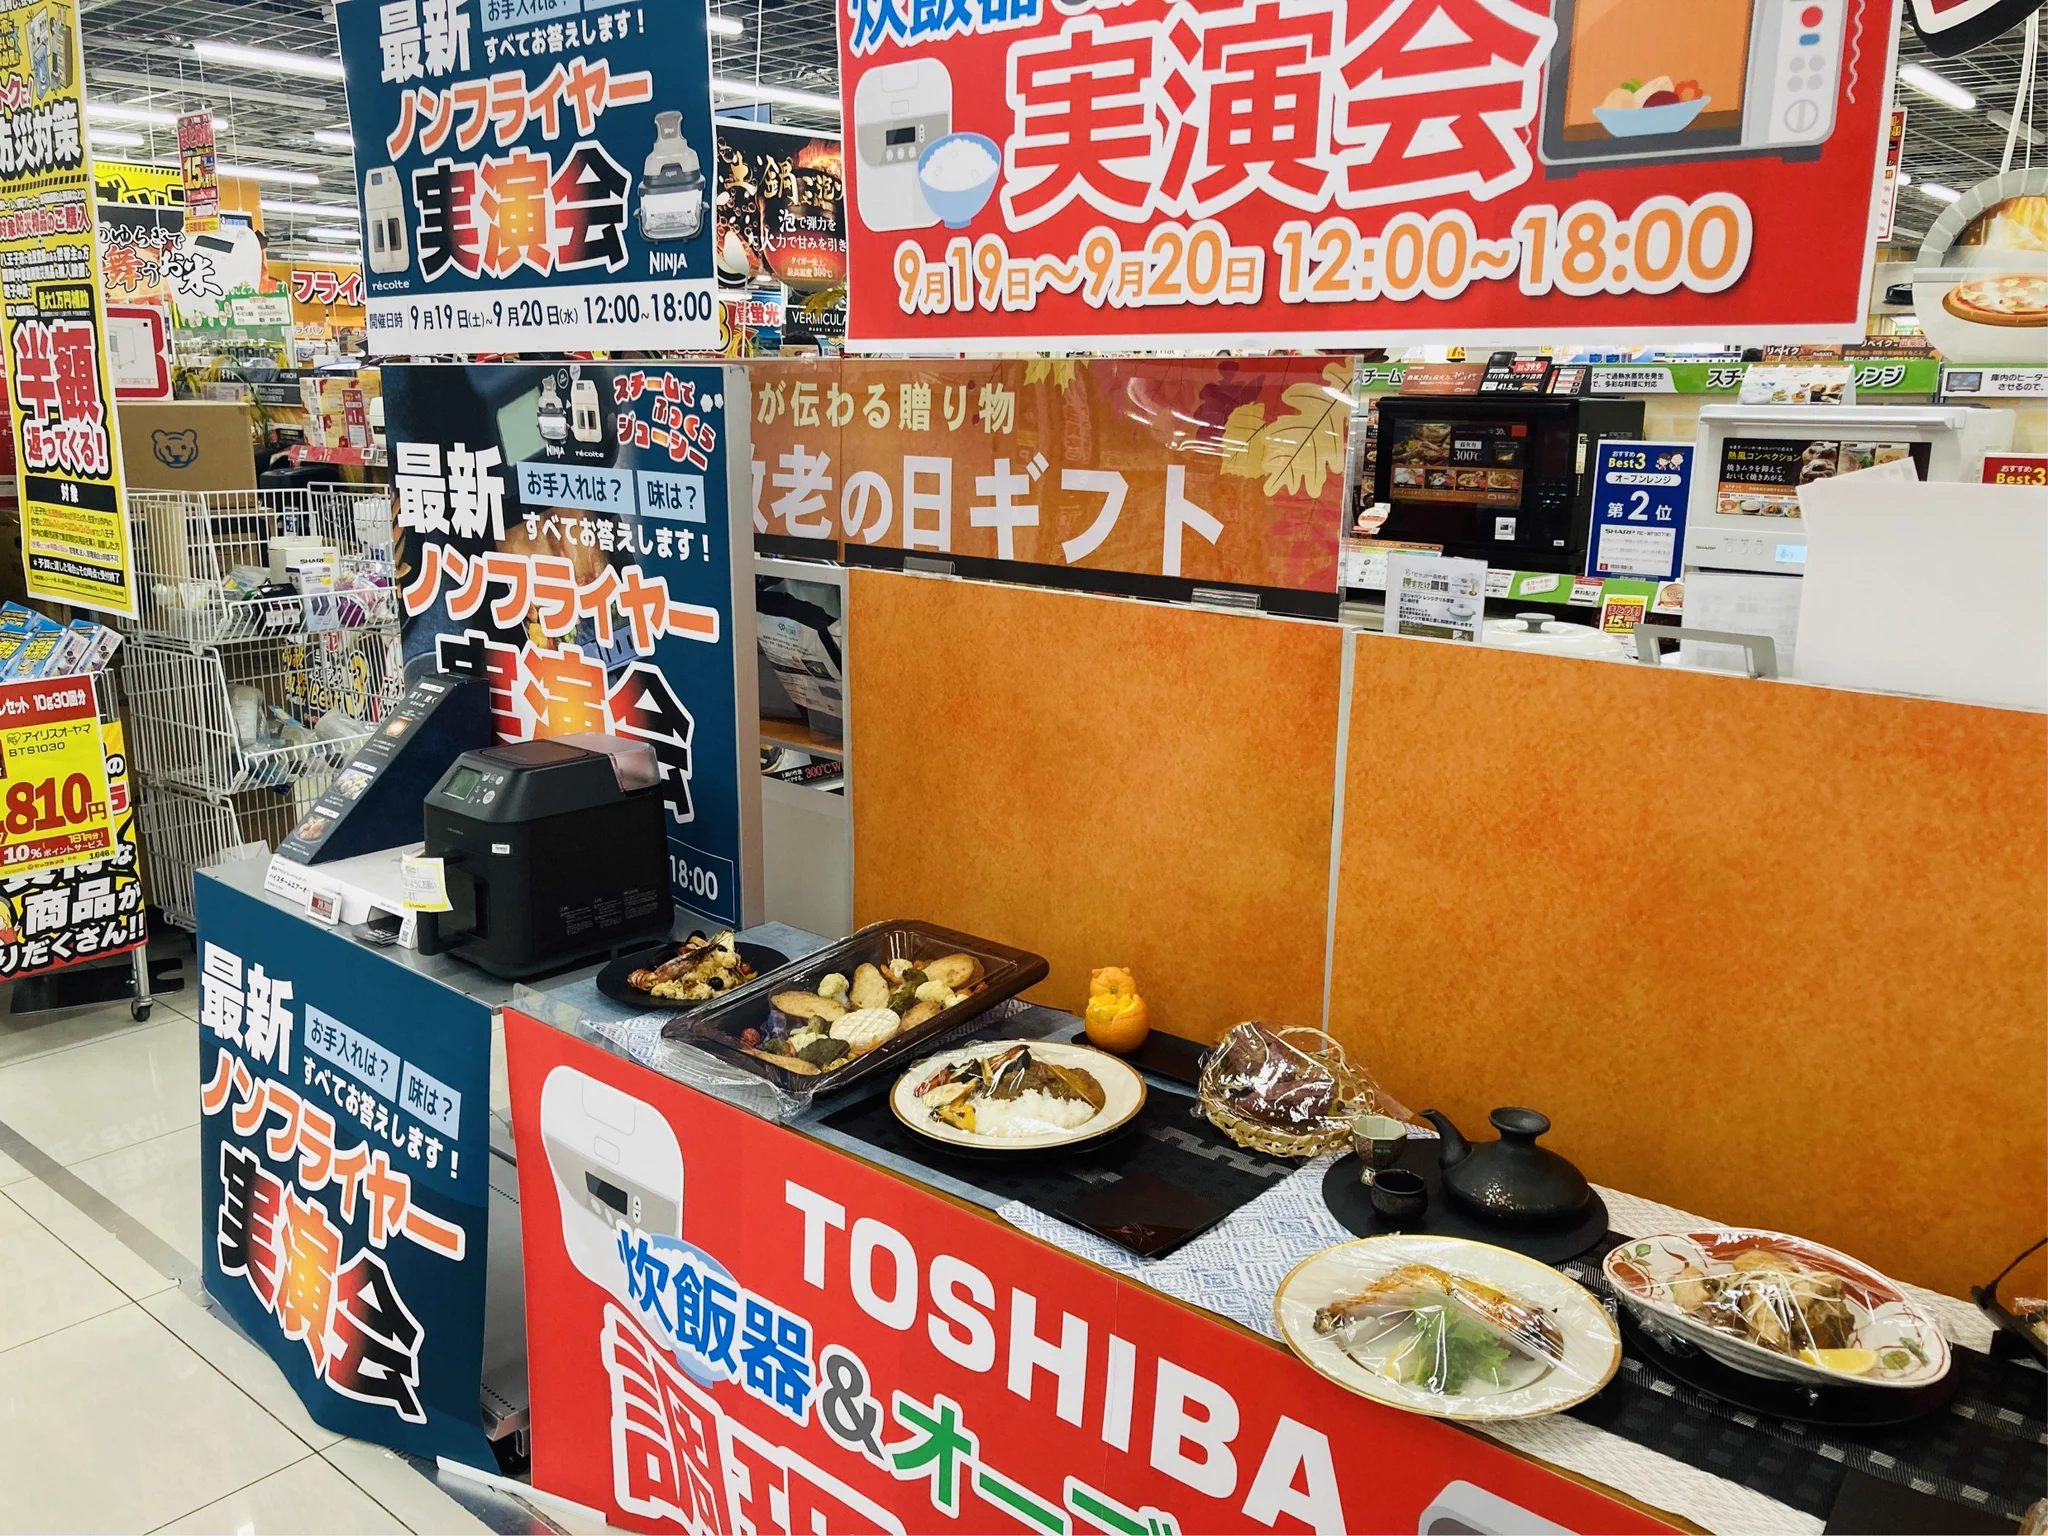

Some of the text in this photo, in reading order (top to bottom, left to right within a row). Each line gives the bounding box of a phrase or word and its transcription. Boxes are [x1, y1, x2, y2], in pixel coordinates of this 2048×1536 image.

[379, 0, 471, 84] 最新
[484, 9, 645, 63] すべてお答えします!
[387, 56, 653, 162] ノンフライヤー
[1003, 0, 1558, 231] 実演会
[411, 141, 633, 284] 実演会
[779, 208, 837, 233] 泡で弾力を
[102, 244, 223, 297] 舞うお米
[292, 271, 365, 306] フライ
[372, 279, 410, 291] récolte
[649, 250, 688, 277] NINJA
[369, 312, 404, 330] 開催日時
[15, 320, 104, 424] 半額
[613, 370, 695, 408] スチームで
[1354, 367, 1405, 386] スチーム
[1707, 368, 1746, 387] スチ
[652, 395, 717, 453] ふっくら
[751, 380, 1016, 435] が伝わる贈り物
[24, 419, 109, 474] 返ってくる!
[545, 443, 566, 460] NINJA
[616, 411, 708, 472] ジューシー
[1608, 453, 1646, 470] Best3
[1727, 451, 1801, 462] 熱風コンベクション
[395, 442, 506, 541] 最新
[526, 470, 697, 510] お手入れは? 味は?
[1607, 490, 1673, 521] 第2位
[521, 510, 711, 563] すべてお答えします!
[402, 542, 719, 656] ノンフライヤー
[1606, 615, 1638, 628] 15%引
[9, 741, 66, 758] BTS1030
[22, 723, 91, 743] アイリスオーヤマ
[669, 854, 719, 901] 18:00
[25, 876, 141, 936] 商品が
[200, 941, 295, 1074] 最新
[310, 1019, 454, 1118] お手入れは? 味は?
[303, 1056, 460, 1179] すべてお答えします!
[201, 1047, 465, 1261] ノンフライヤー
[218, 1140, 428, 1424] 実演会
[785, 1179, 1347, 1536] TOSHIBA
